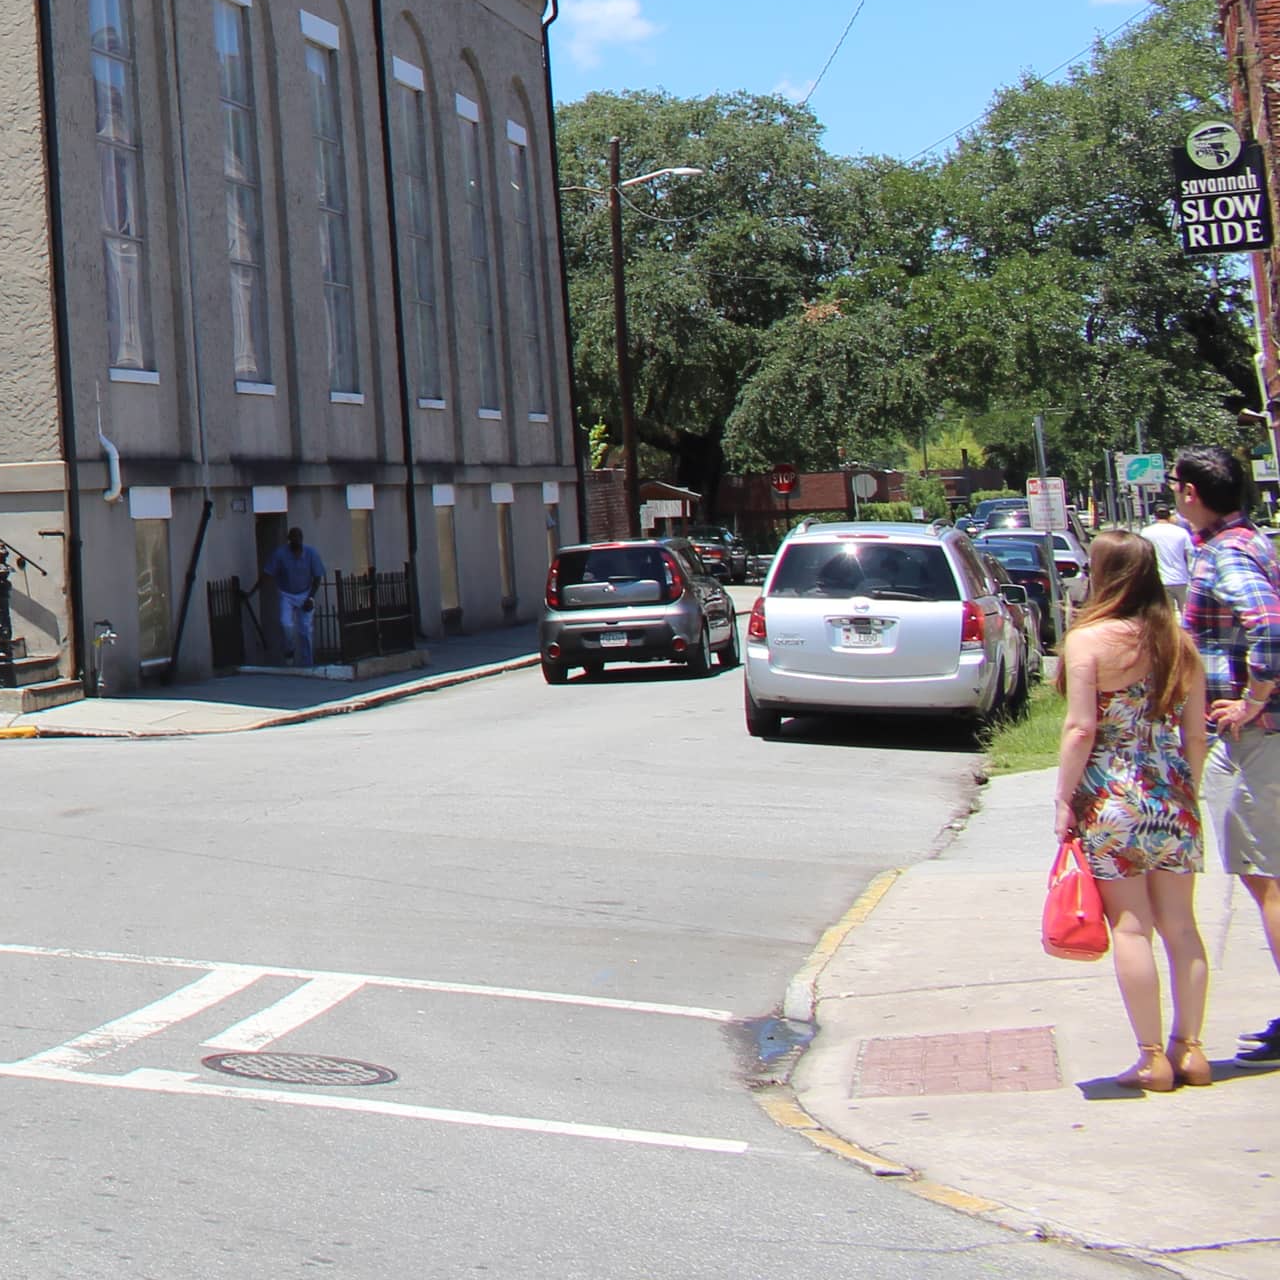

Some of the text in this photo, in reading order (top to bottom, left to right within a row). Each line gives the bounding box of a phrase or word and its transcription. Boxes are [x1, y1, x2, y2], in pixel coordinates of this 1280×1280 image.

[1180, 167, 1258, 195] savannah
[1181, 194, 1262, 223] SLOW
[1187, 220, 1264, 248] RIDE
[772, 472, 796, 484] STOP
